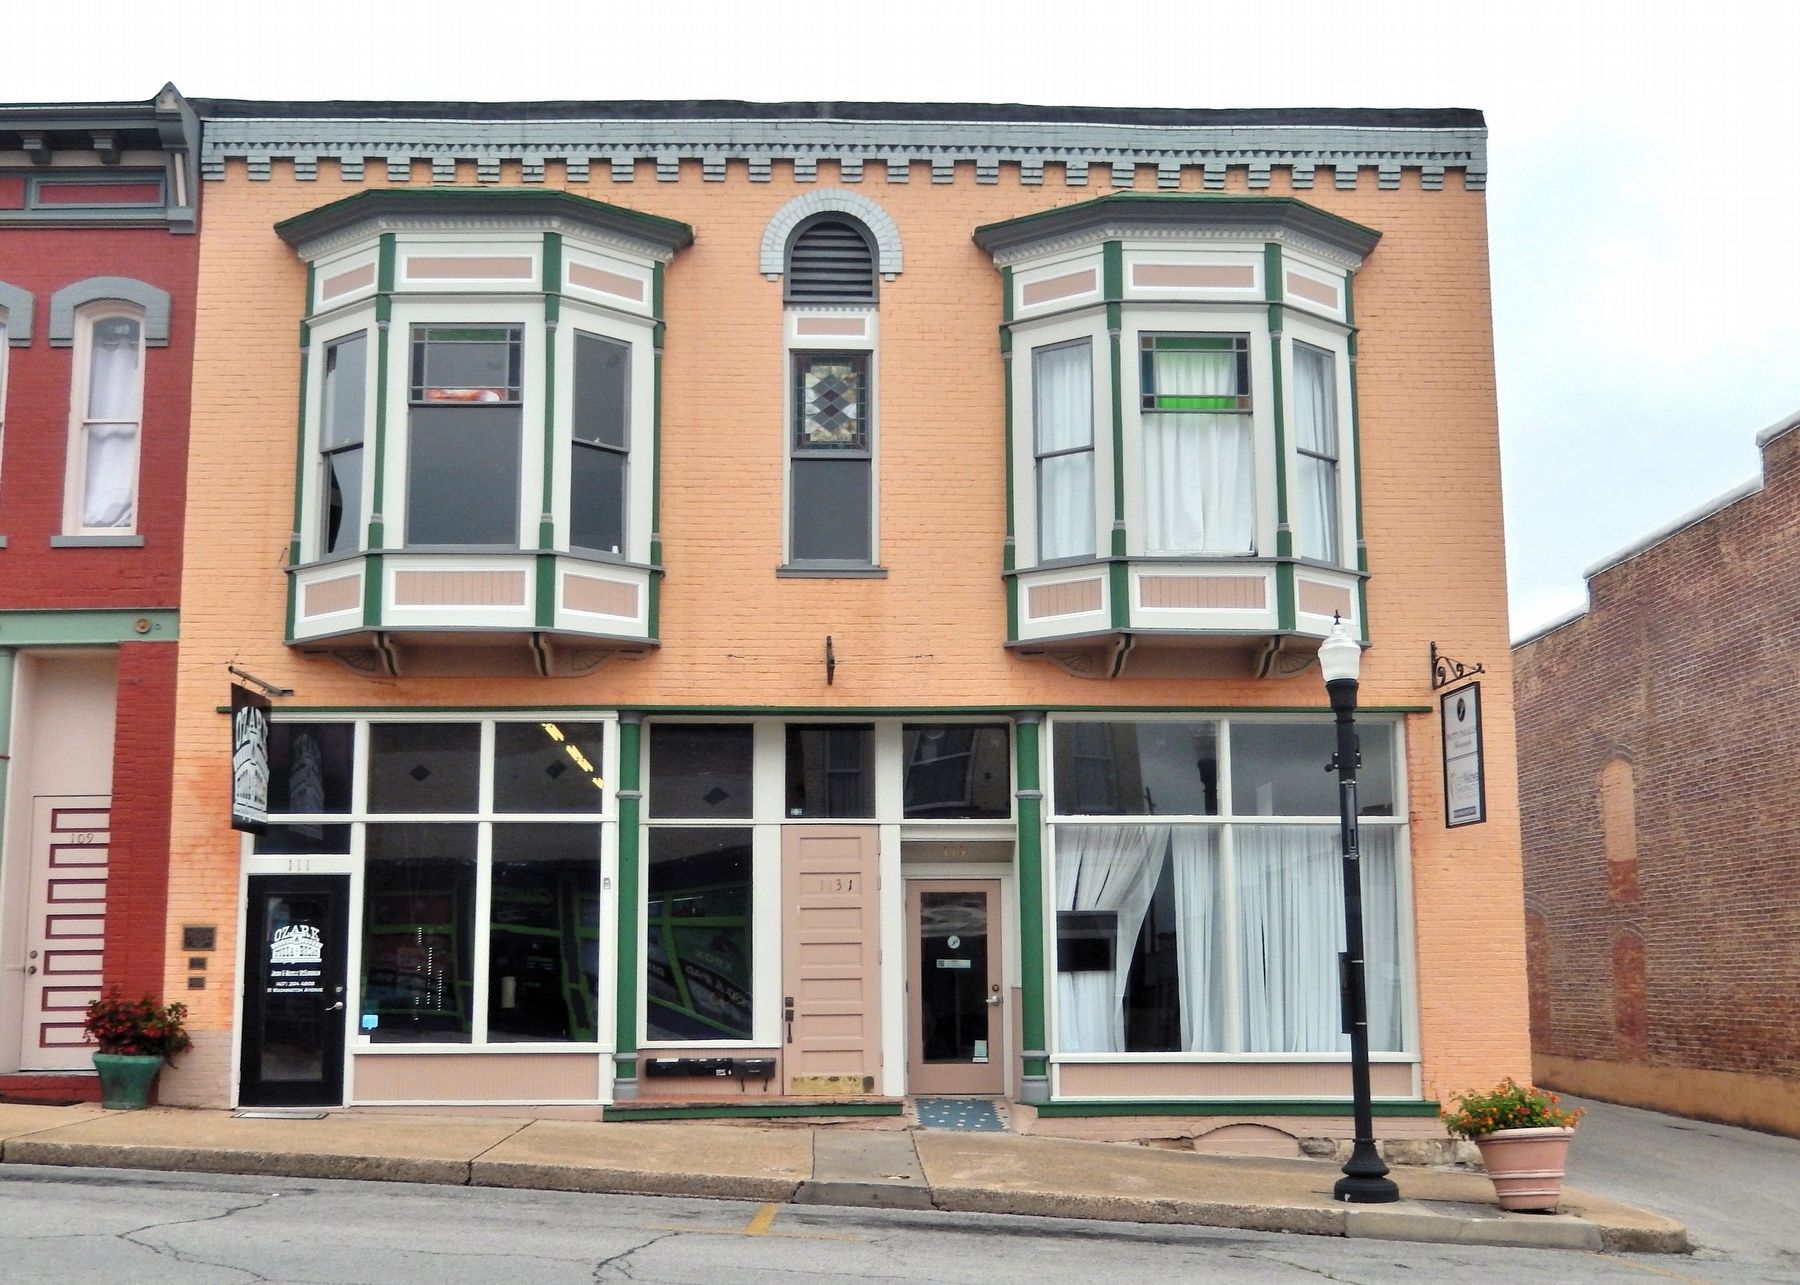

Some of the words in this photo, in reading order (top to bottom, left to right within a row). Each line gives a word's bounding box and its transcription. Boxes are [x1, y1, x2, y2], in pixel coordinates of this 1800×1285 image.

[71, 832, 94, 844] 109
[289, 859, 310, 871] 111
[274, 925, 320, 942] OZARK
